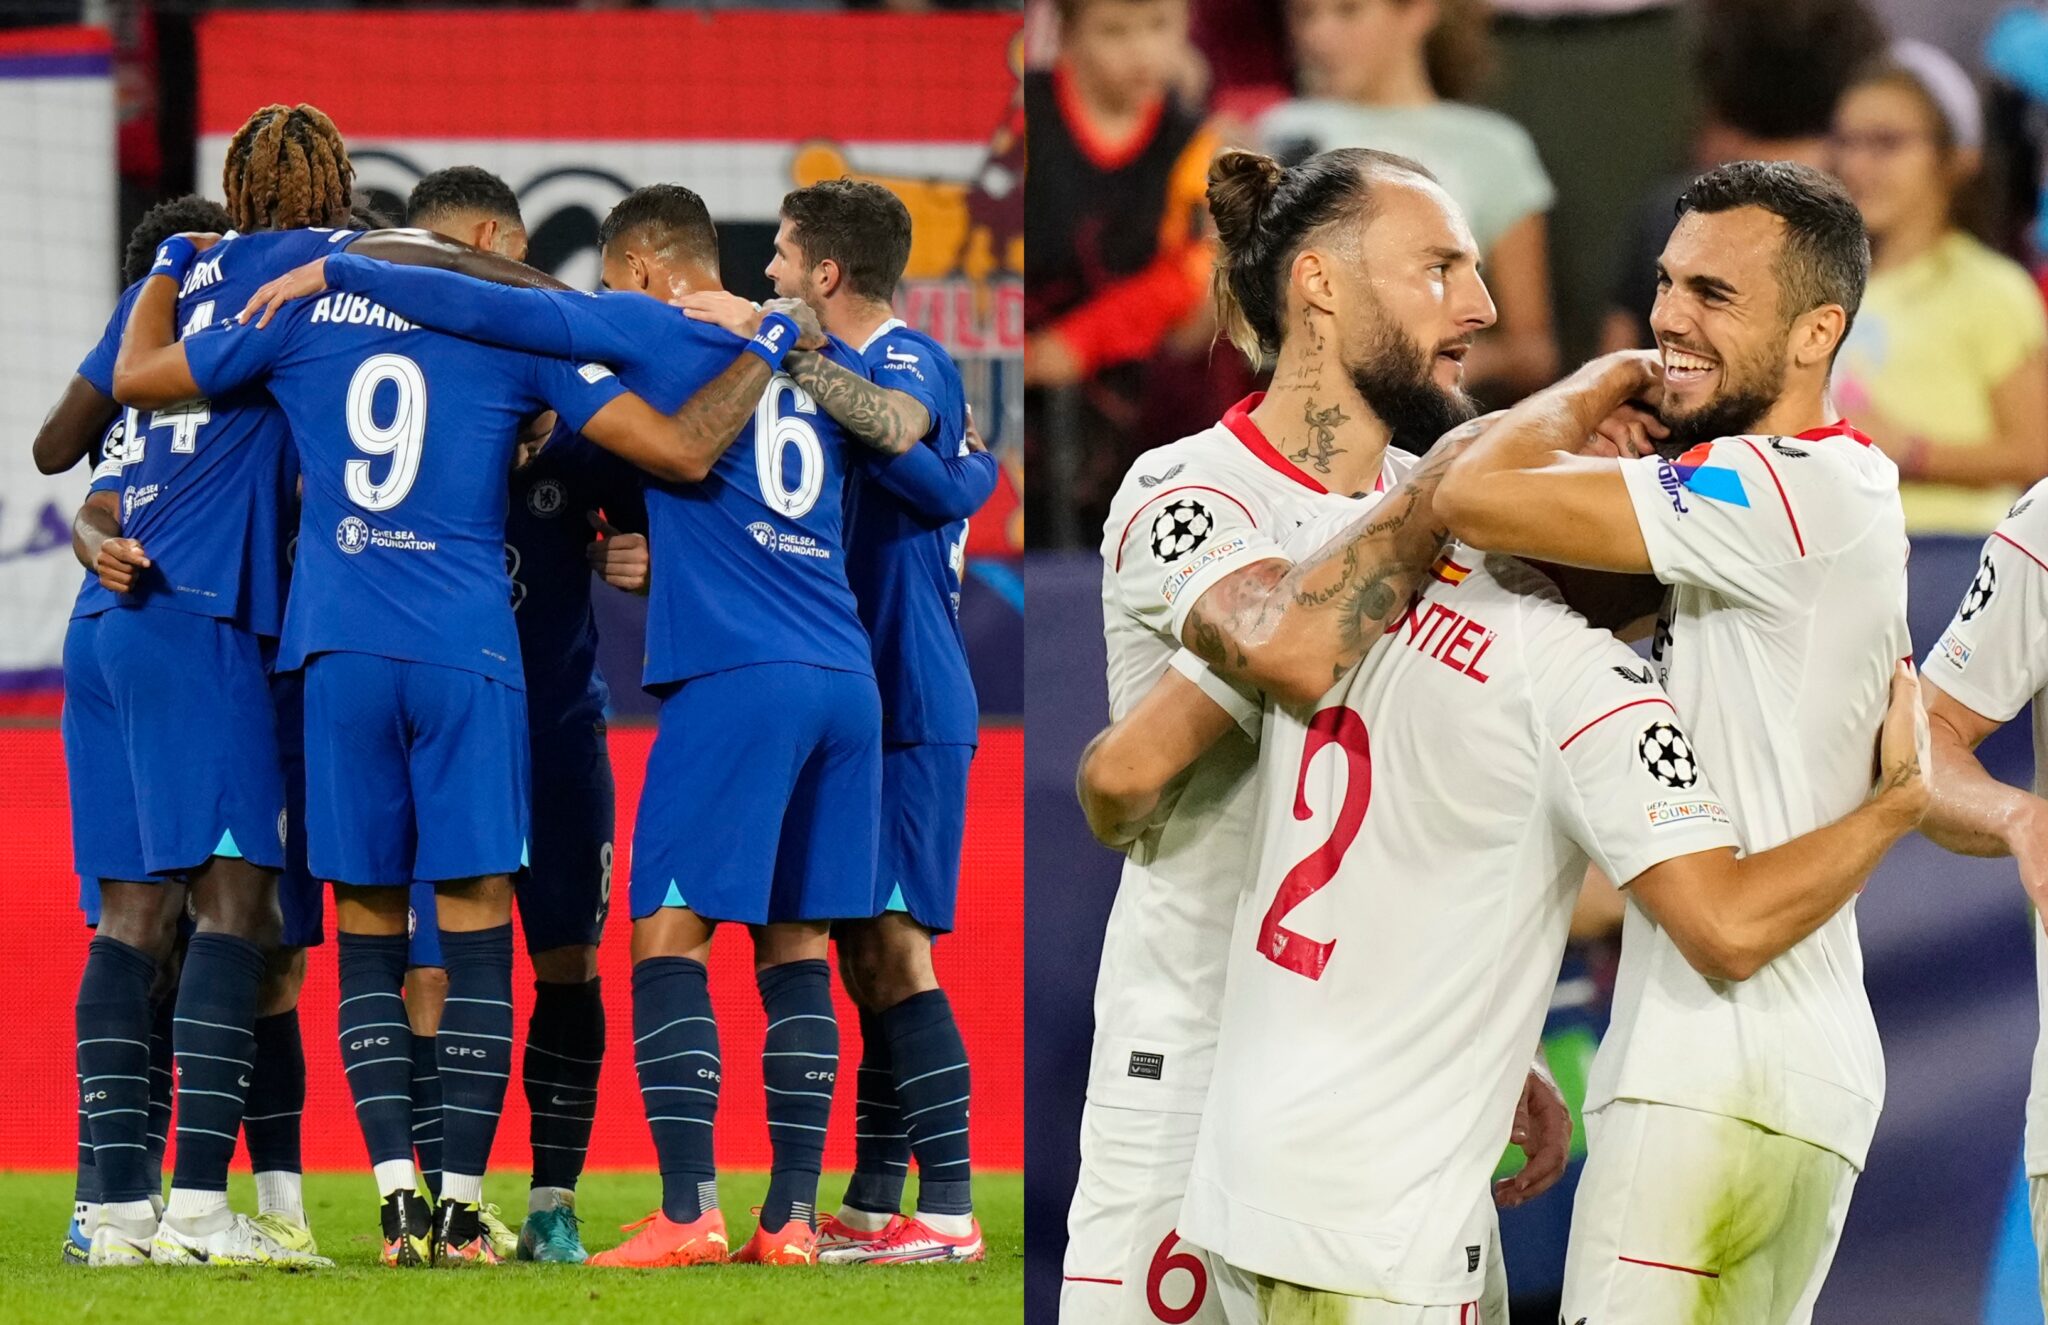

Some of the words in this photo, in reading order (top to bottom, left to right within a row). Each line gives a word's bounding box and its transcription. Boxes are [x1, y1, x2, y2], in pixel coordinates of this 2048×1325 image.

[344, 353, 428, 512] 9
[755, 373, 824, 520] 6
[371, 528, 416, 541] CHELSEA
[778, 533, 816, 547] CHELSEA
[370, 537, 437, 551] FOUNDATION
[778, 543, 831, 560] FOUNDATION
[1164, 539, 1245, 604] FOUNDATION
[1384, 590, 1498, 684] NTIEL
[1256, 705, 1372, 981] 2
[600, 841, 614, 905] 8
[350, 1036, 390, 1050] CFC
[445, 1046, 487, 1058] CFC
[804, 1071, 835, 1082] CFC
[84, 1090, 108, 1103] CFC
[1146, 1227, 1208, 1325] 6
